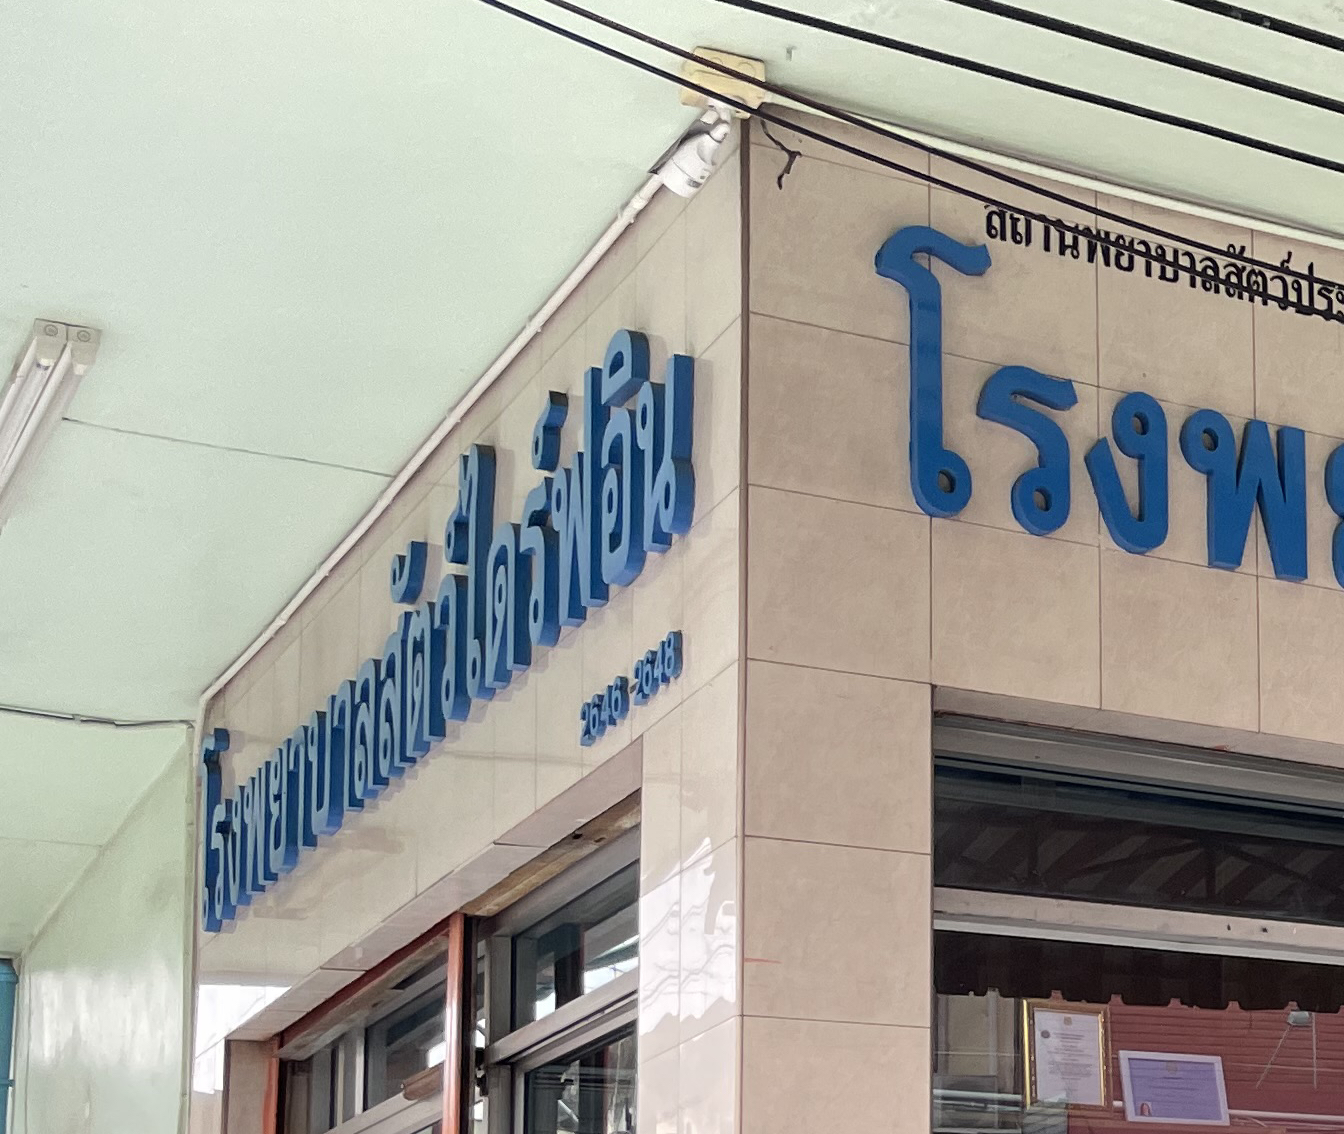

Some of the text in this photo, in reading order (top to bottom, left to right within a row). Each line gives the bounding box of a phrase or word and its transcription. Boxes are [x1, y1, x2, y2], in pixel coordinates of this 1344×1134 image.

[202, 328, 695, 934] โรงพยาบาลสัตว์ไดร์ฟอิน
